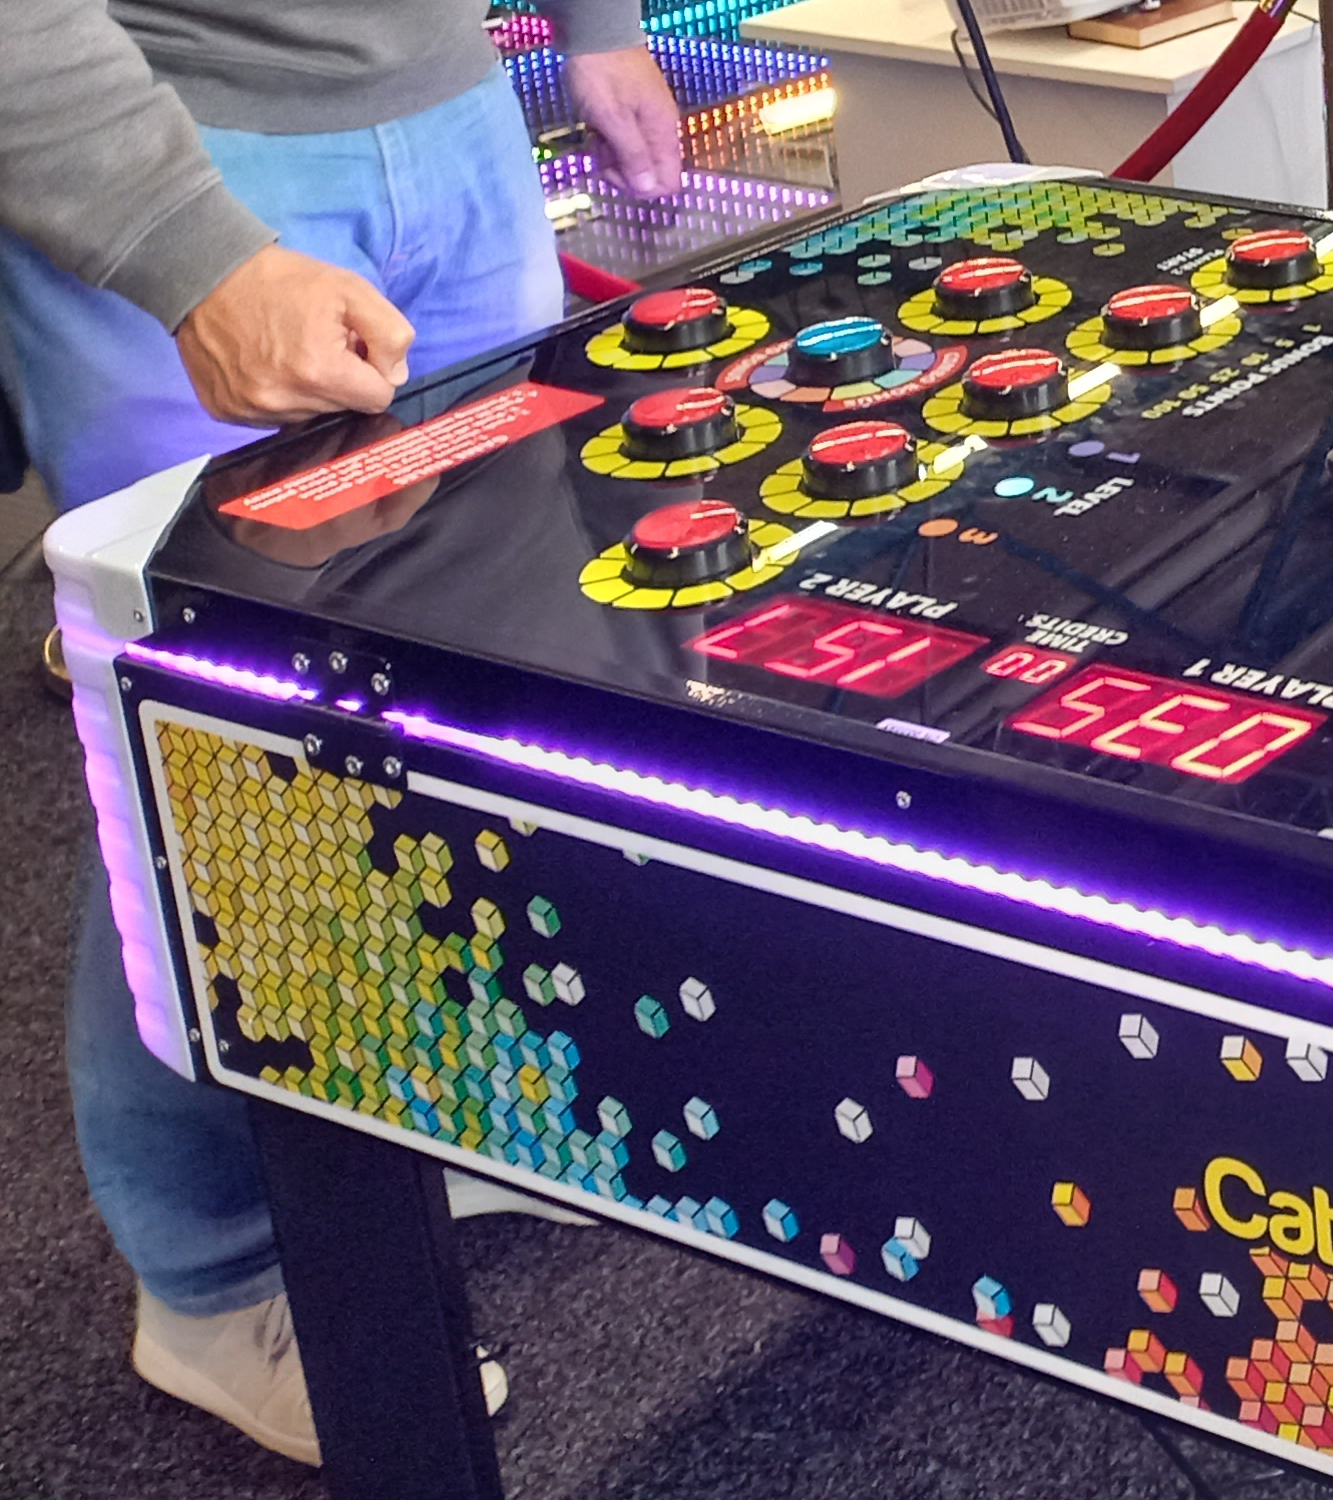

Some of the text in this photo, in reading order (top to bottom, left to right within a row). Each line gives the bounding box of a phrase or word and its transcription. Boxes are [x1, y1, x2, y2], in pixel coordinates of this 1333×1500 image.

[1240, 352, 1269, 366] 10
[1181, 372, 1268, 418] POINTS
[1105, 452, 1141, 463] 1
[1031, 487, 1074, 504] 2
[1053, 476, 1135, 517] LEVEL
[958, 527, 999, 545] 3
[799, 573, 959, 619] PLAYER 2
[1024, 629, 1090, 653] TIME
[1026, 613, 1129, 646] CREDITS
[1182, 658, 1212, 677] 1
[1011, 676, 1312, 778] 035
